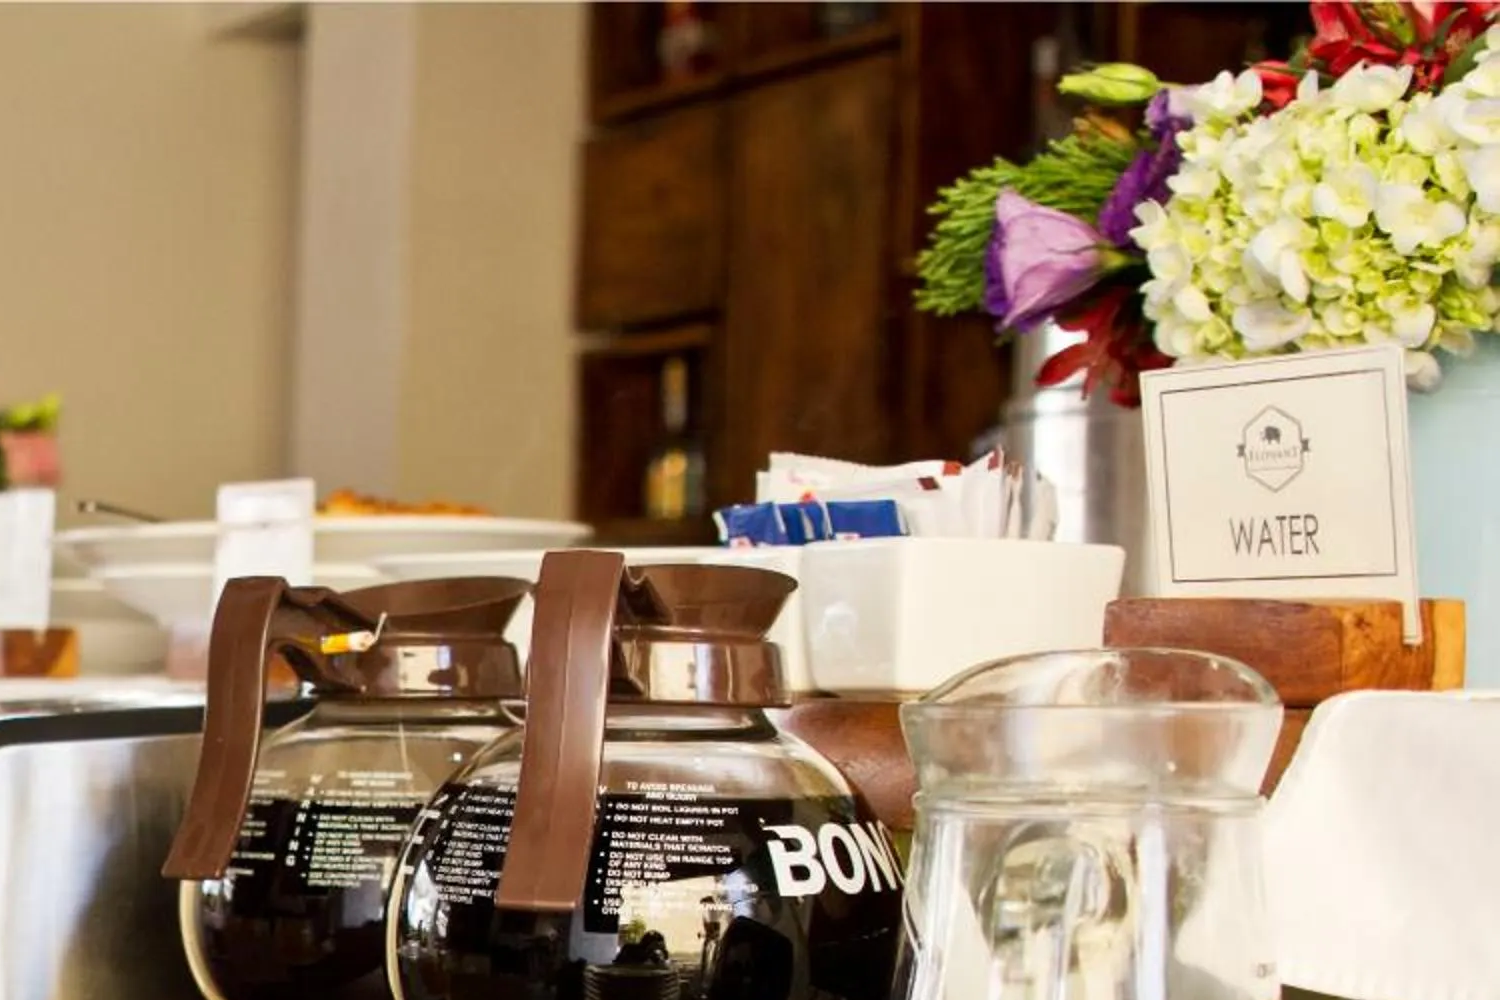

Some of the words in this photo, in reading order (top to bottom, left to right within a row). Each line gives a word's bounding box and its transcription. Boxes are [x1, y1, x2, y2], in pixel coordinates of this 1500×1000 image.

[1229, 513, 1320, 557] WATER
[650, 816, 674, 825] HEAT
[627, 832, 647, 841] NOT
[648, 833, 678, 842] CLEAN
[625, 852, 645, 861] NOT
[623, 869, 642, 878] NOT
